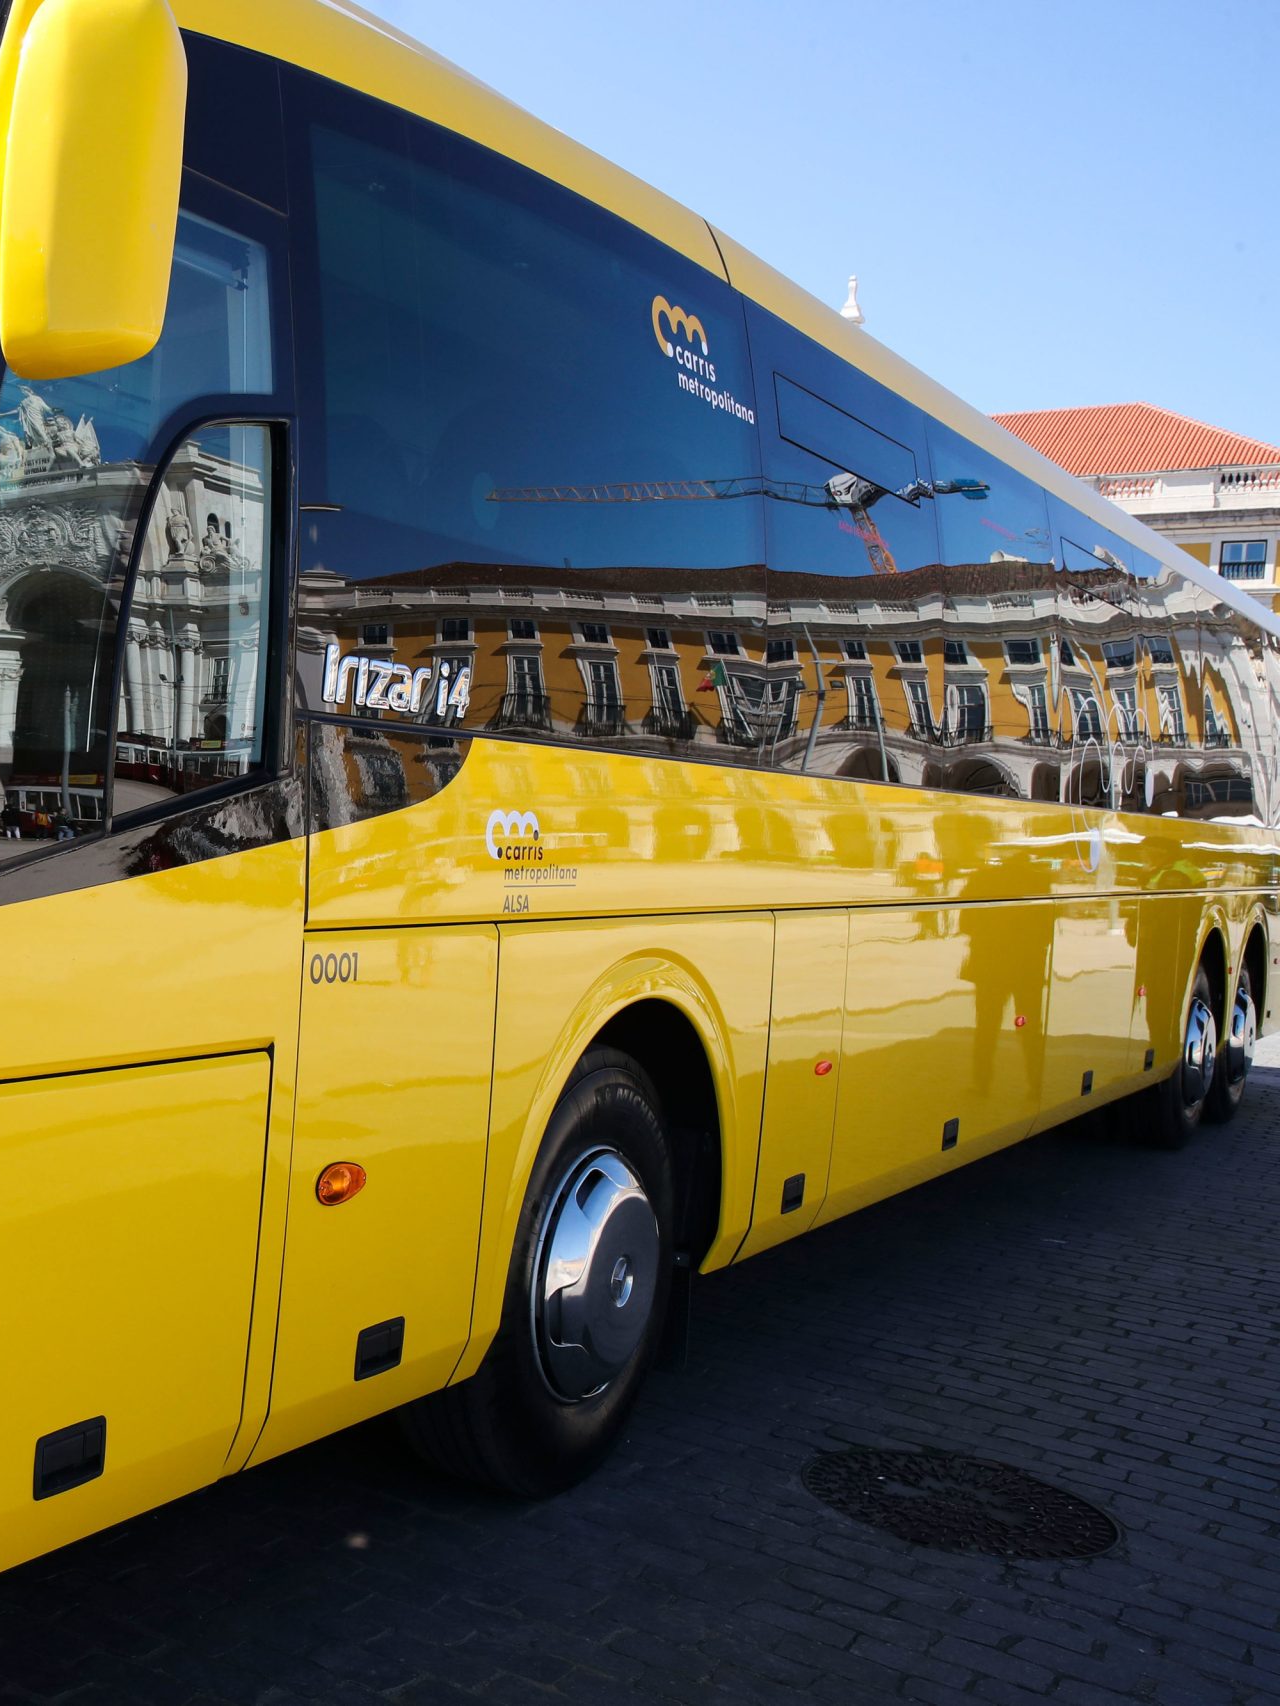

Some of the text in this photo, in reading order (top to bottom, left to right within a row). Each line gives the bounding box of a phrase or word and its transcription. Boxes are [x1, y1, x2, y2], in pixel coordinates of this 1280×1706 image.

[675, 345, 716, 382] carris
[677, 371, 755, 425] metropolitana
[322, 643, 470, 718] Irizar i4
[505, 845, 543, 860] carris
[504, 864, 577, 884] metropolitana
[503, 894, 529, 913] ALSA
[310, 952, 358, 984] 0001
